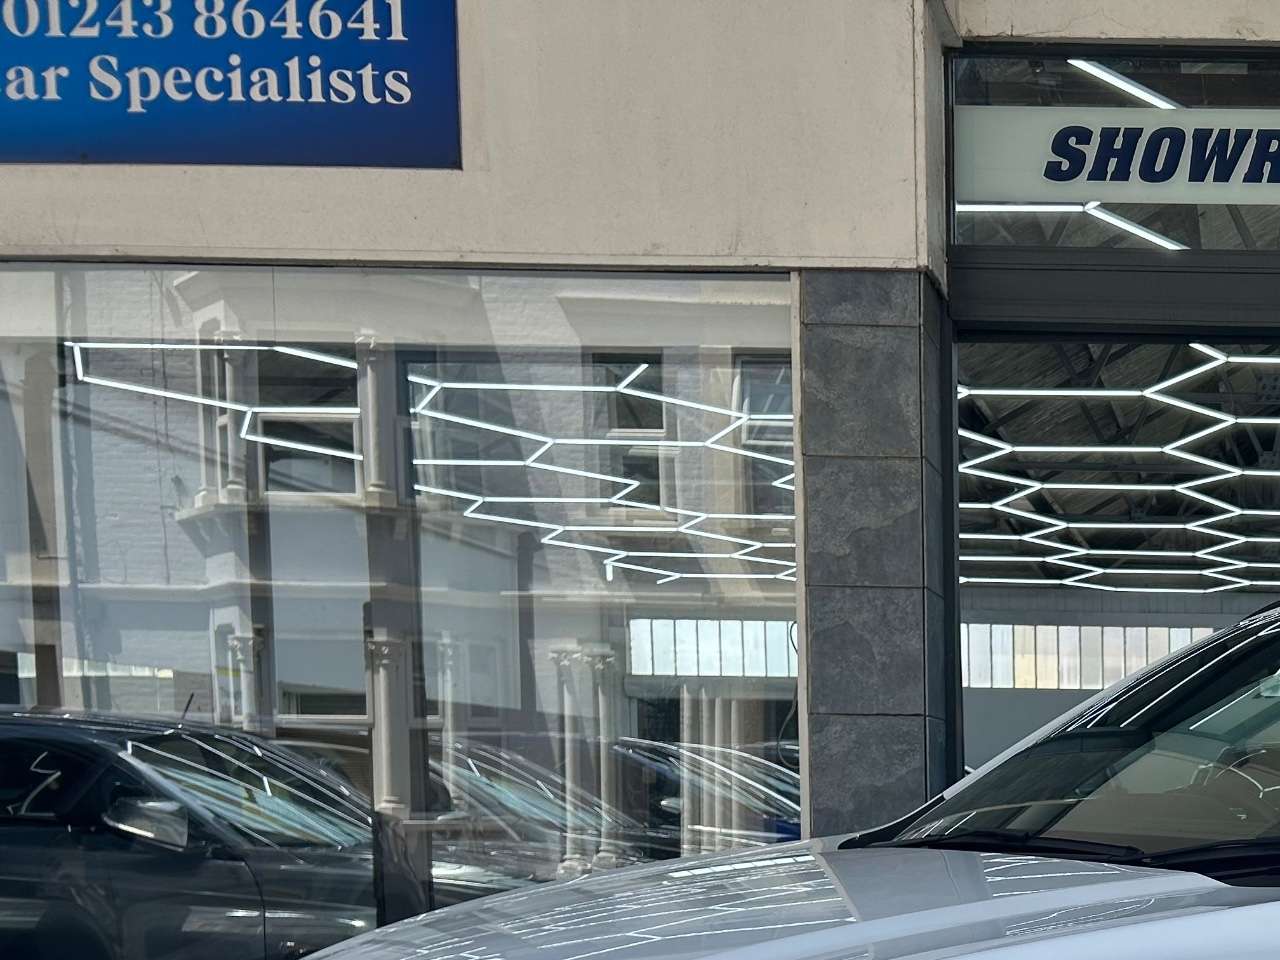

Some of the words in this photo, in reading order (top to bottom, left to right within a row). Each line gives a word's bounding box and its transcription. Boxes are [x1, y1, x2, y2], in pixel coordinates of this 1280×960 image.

[2, 0, 173, 38] 01243
[194, 0, 408, 41] 864641
[0, 65, 70, 100] ar
[88, 54, 411, 112] Specialists
